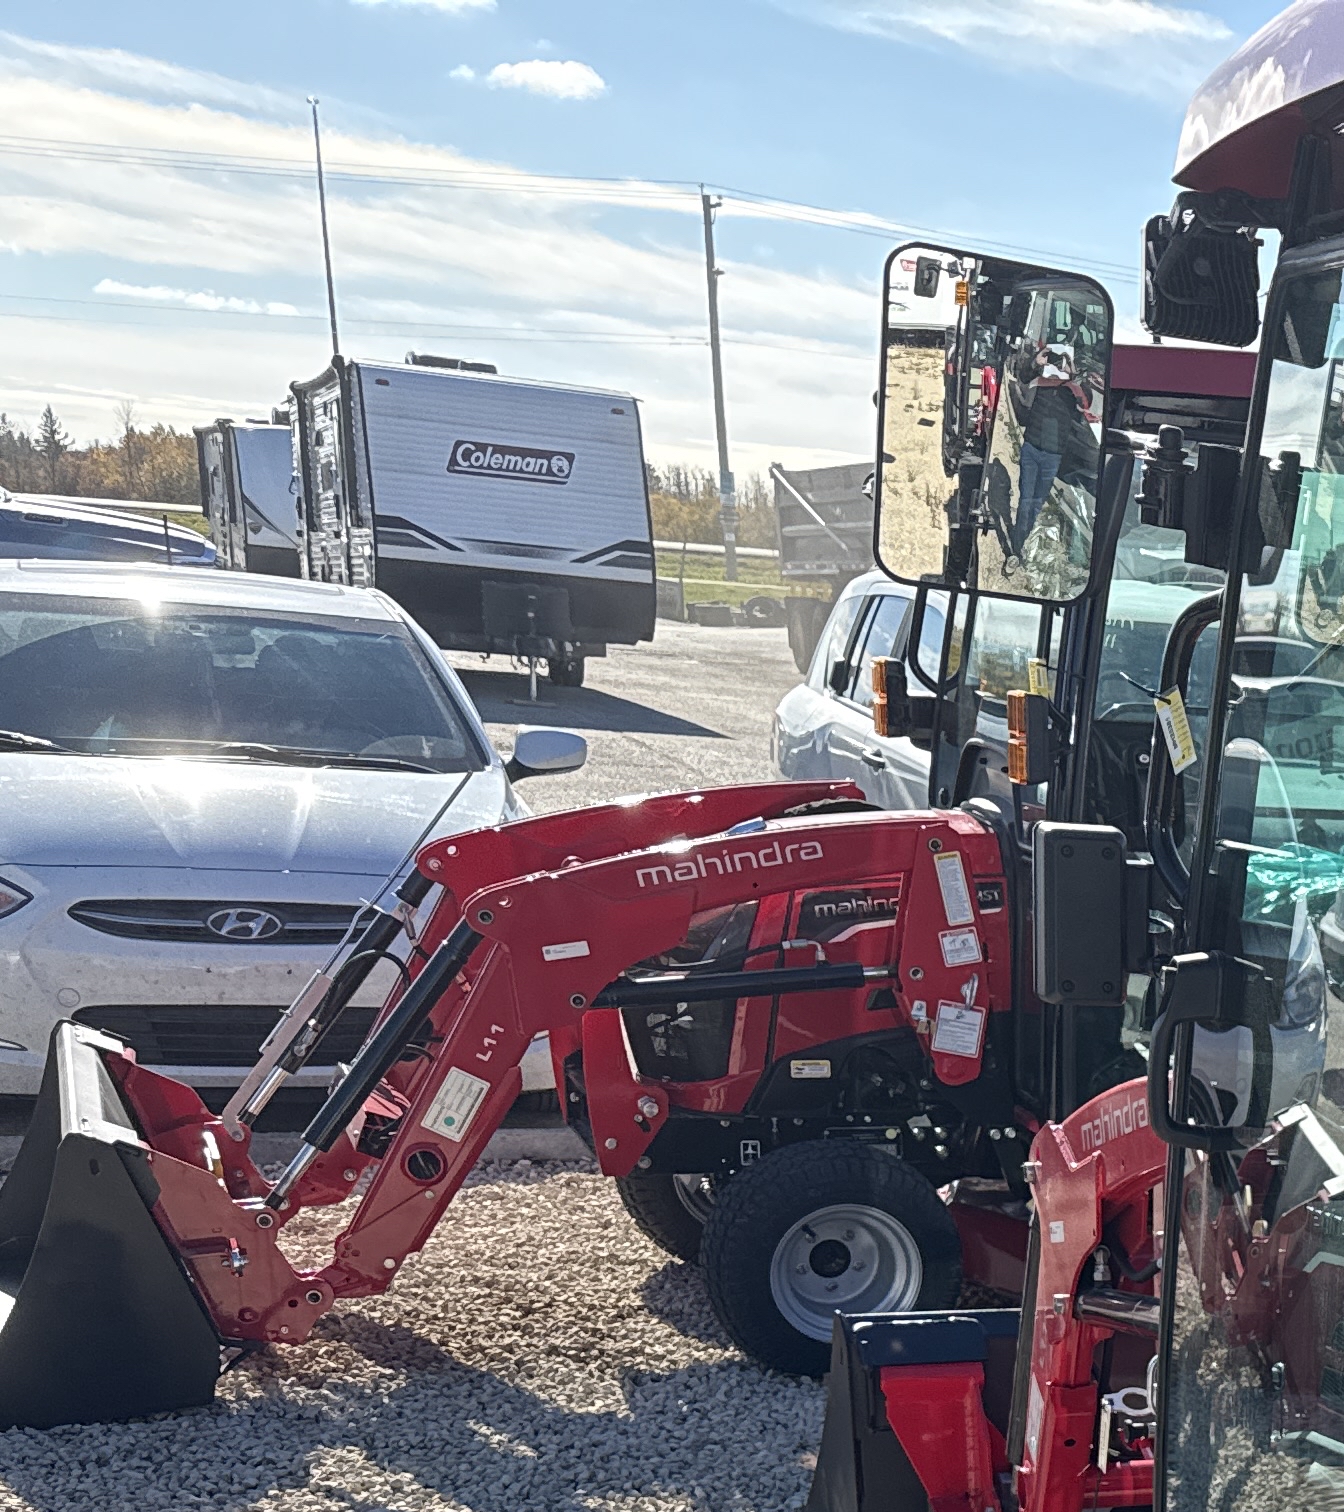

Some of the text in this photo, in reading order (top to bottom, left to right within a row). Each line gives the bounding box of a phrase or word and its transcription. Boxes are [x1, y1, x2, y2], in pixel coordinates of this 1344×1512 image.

[456, 442, 549, 474] Coleman
[635, 840, 824, 888] mahindra
[814, 896, 900, 918] mahin
[476, 1024, 504, 1062] L11
[1081, 1094, 1149, 1152] mahindra
